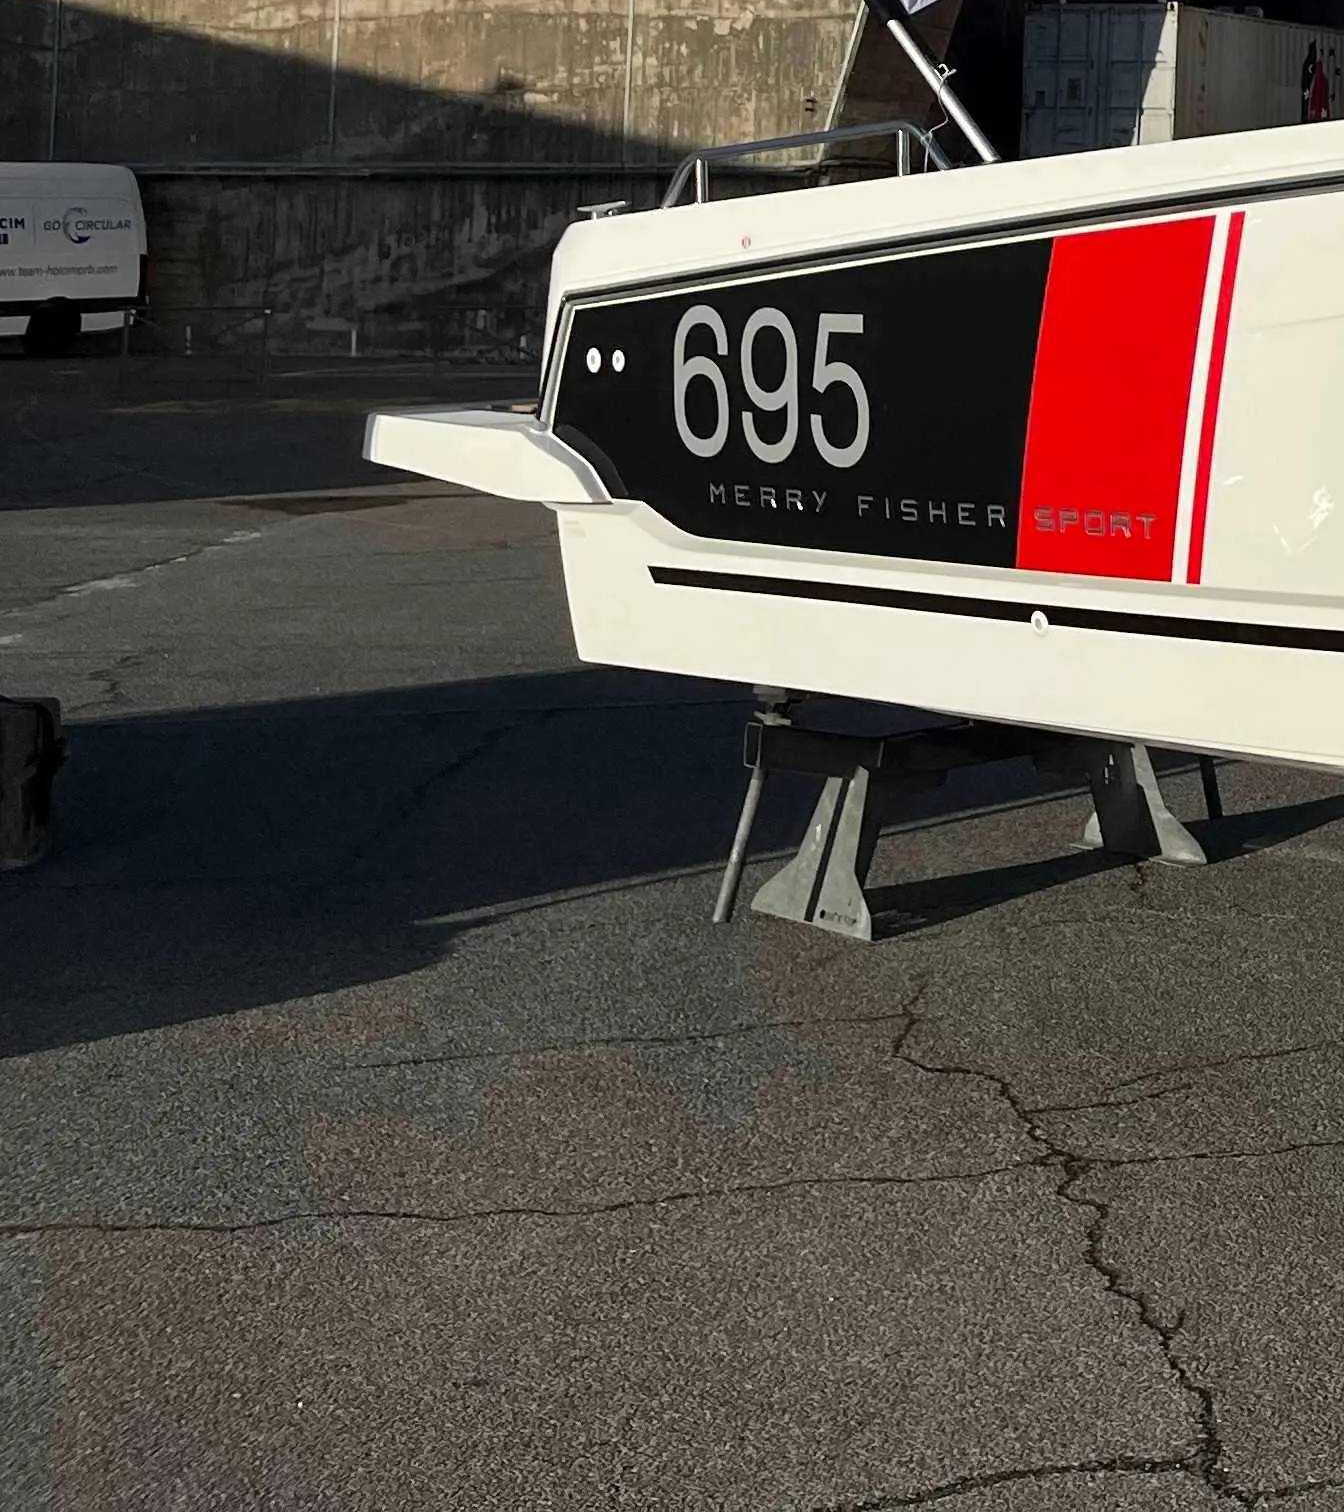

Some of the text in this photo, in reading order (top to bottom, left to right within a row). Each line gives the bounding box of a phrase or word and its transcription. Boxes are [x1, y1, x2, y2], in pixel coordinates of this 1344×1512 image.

[43, 220, 61, 231] GO
[673, 304, 870, 468] 695
[709, 483, 1158, 541] MERRY FISHER SPORT
